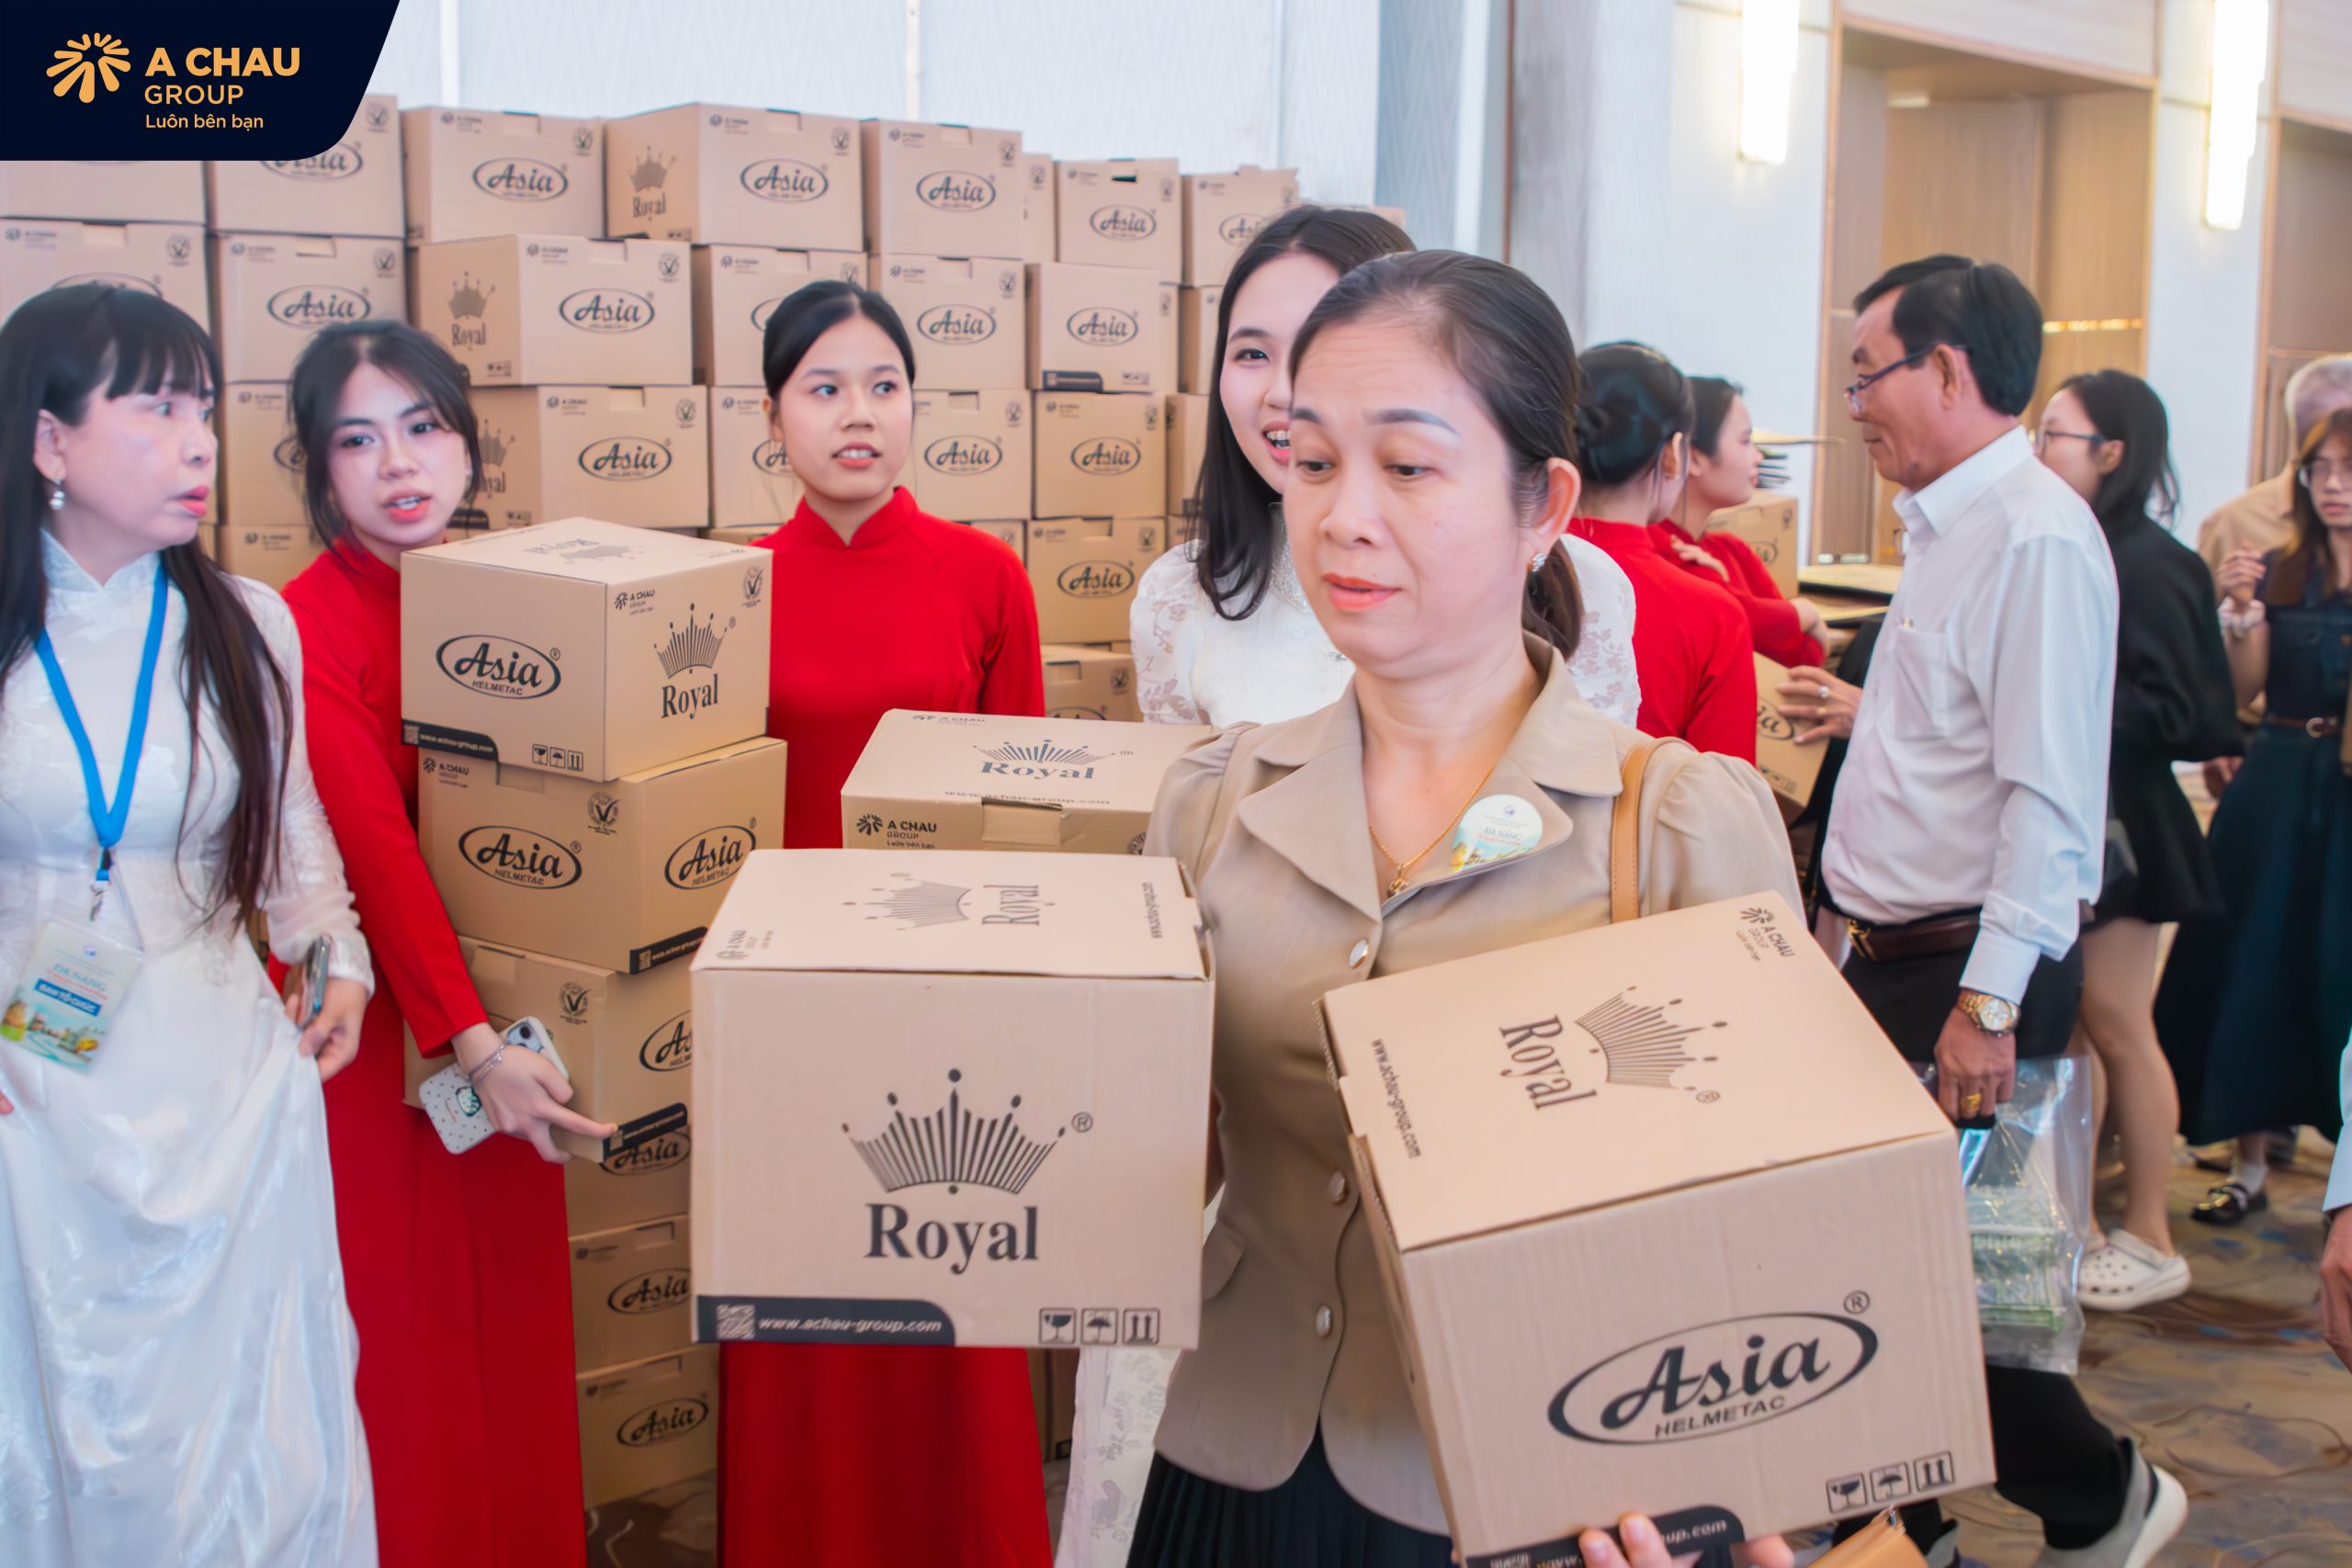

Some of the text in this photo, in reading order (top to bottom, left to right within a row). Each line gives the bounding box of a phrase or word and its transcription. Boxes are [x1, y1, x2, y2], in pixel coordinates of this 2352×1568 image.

[487, 163, 553, 192] Asia
[754, 164, 816, 193] Asia
[928, 175, 985, 202] Asia
[1100, 209, 1148, 232] Asia
[283, 289, 357, 319] Asia
[573, 294, 641, 322] Asia
[929, 309, 985, 335] Asia
[1078, 311, 1128, 337] Asia
[593, 442, 659, 470] Asia
[935, 440, 992, 468] Asia
[1081, 442, 1131, 468] Asia
[1069, 567, 1124, 591] Asia
[454, 641, 543, 688] Asia
[471, 680, 524, 696] HELMETAC
[661, 672, 719, 719] Royal
[980, 761, 1095, 780] Royal
[887, 819, 937, 833] A CHAU
[887, 831, 919, 840] GROUP
[476, 832, 563, 879] Asia
[678, 835, 743, 882] Asia
[982, 885, 1056, 926] Royal
[1768, 932, 1796, 957] CHAU
[1498, 1013, 1599, 1111] Royal
[1371, 1038, 1422, 1159] www.achau-group.com
[864, 1202, 1039, 1275] Royal
[621, 1274, 688, 1309] Asia
[758, 1315, 943, 1334] www.achau-group.com
[1600, 1335, 1831, 1430] Asia
[630, 1405, 695, 1441] Asia
[1654, 1395, 1787, 1438] HELMETAC
